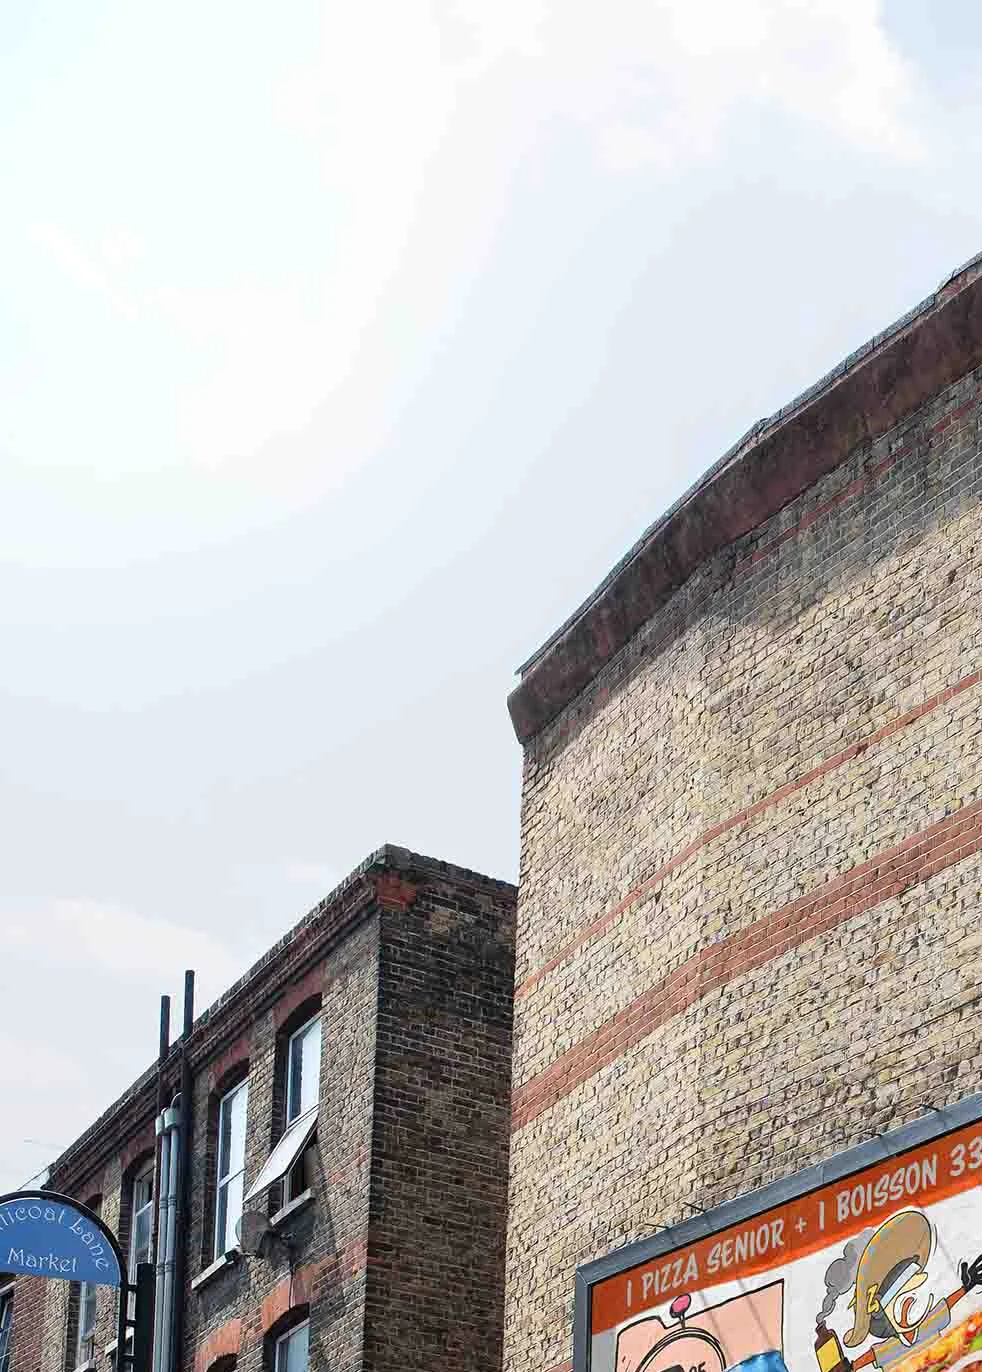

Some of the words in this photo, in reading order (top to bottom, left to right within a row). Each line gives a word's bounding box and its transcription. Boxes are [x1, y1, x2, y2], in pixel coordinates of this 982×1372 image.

[70, 1217, 109, 1271] Lane
[642, 1255, 699, 1301] PIZZA
[706, 1218, 785, 1275] SENIOR
[838, 1156, 937, 1224] BOISSON
[7, 1247, 77, 1273] Market
